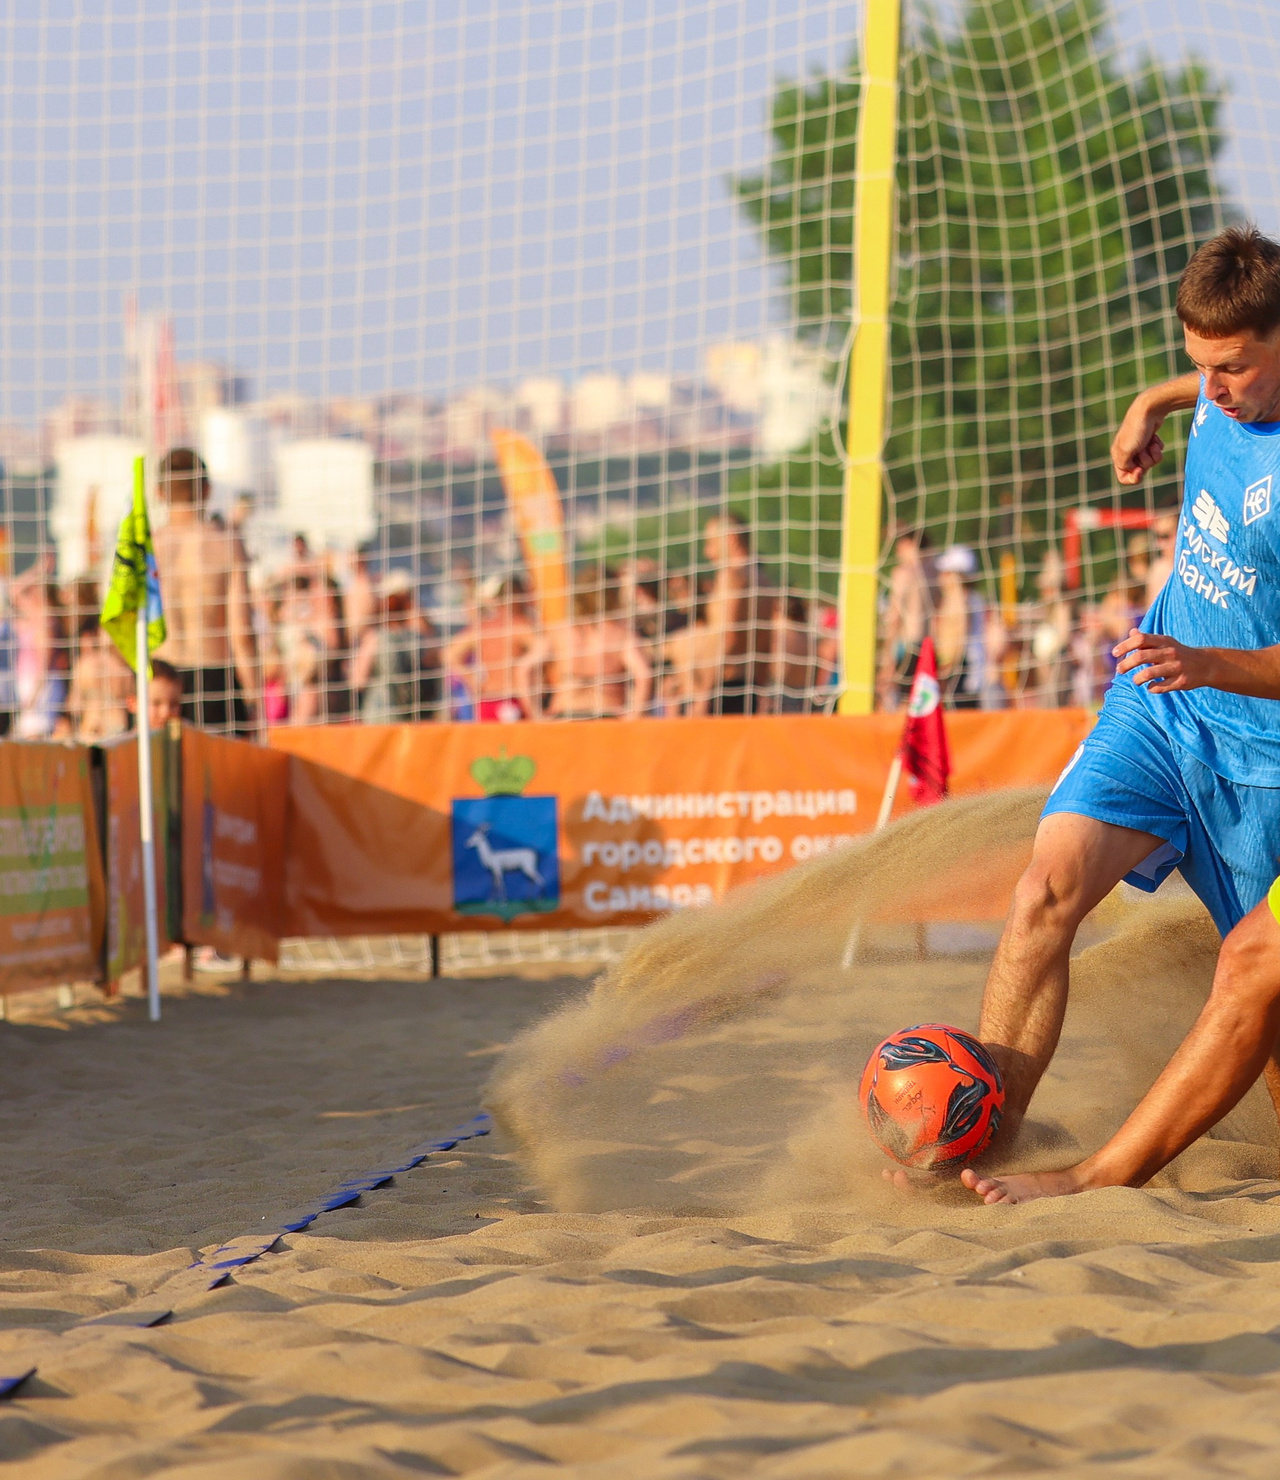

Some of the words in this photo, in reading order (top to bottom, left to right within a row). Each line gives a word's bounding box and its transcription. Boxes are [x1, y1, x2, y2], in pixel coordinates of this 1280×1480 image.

[1178, 549, 1230, 609] банк
[582, 789, 857, 824] Администрация
[583, 834, 783, 871] городского
[583, 880, 713, 912] Самара
